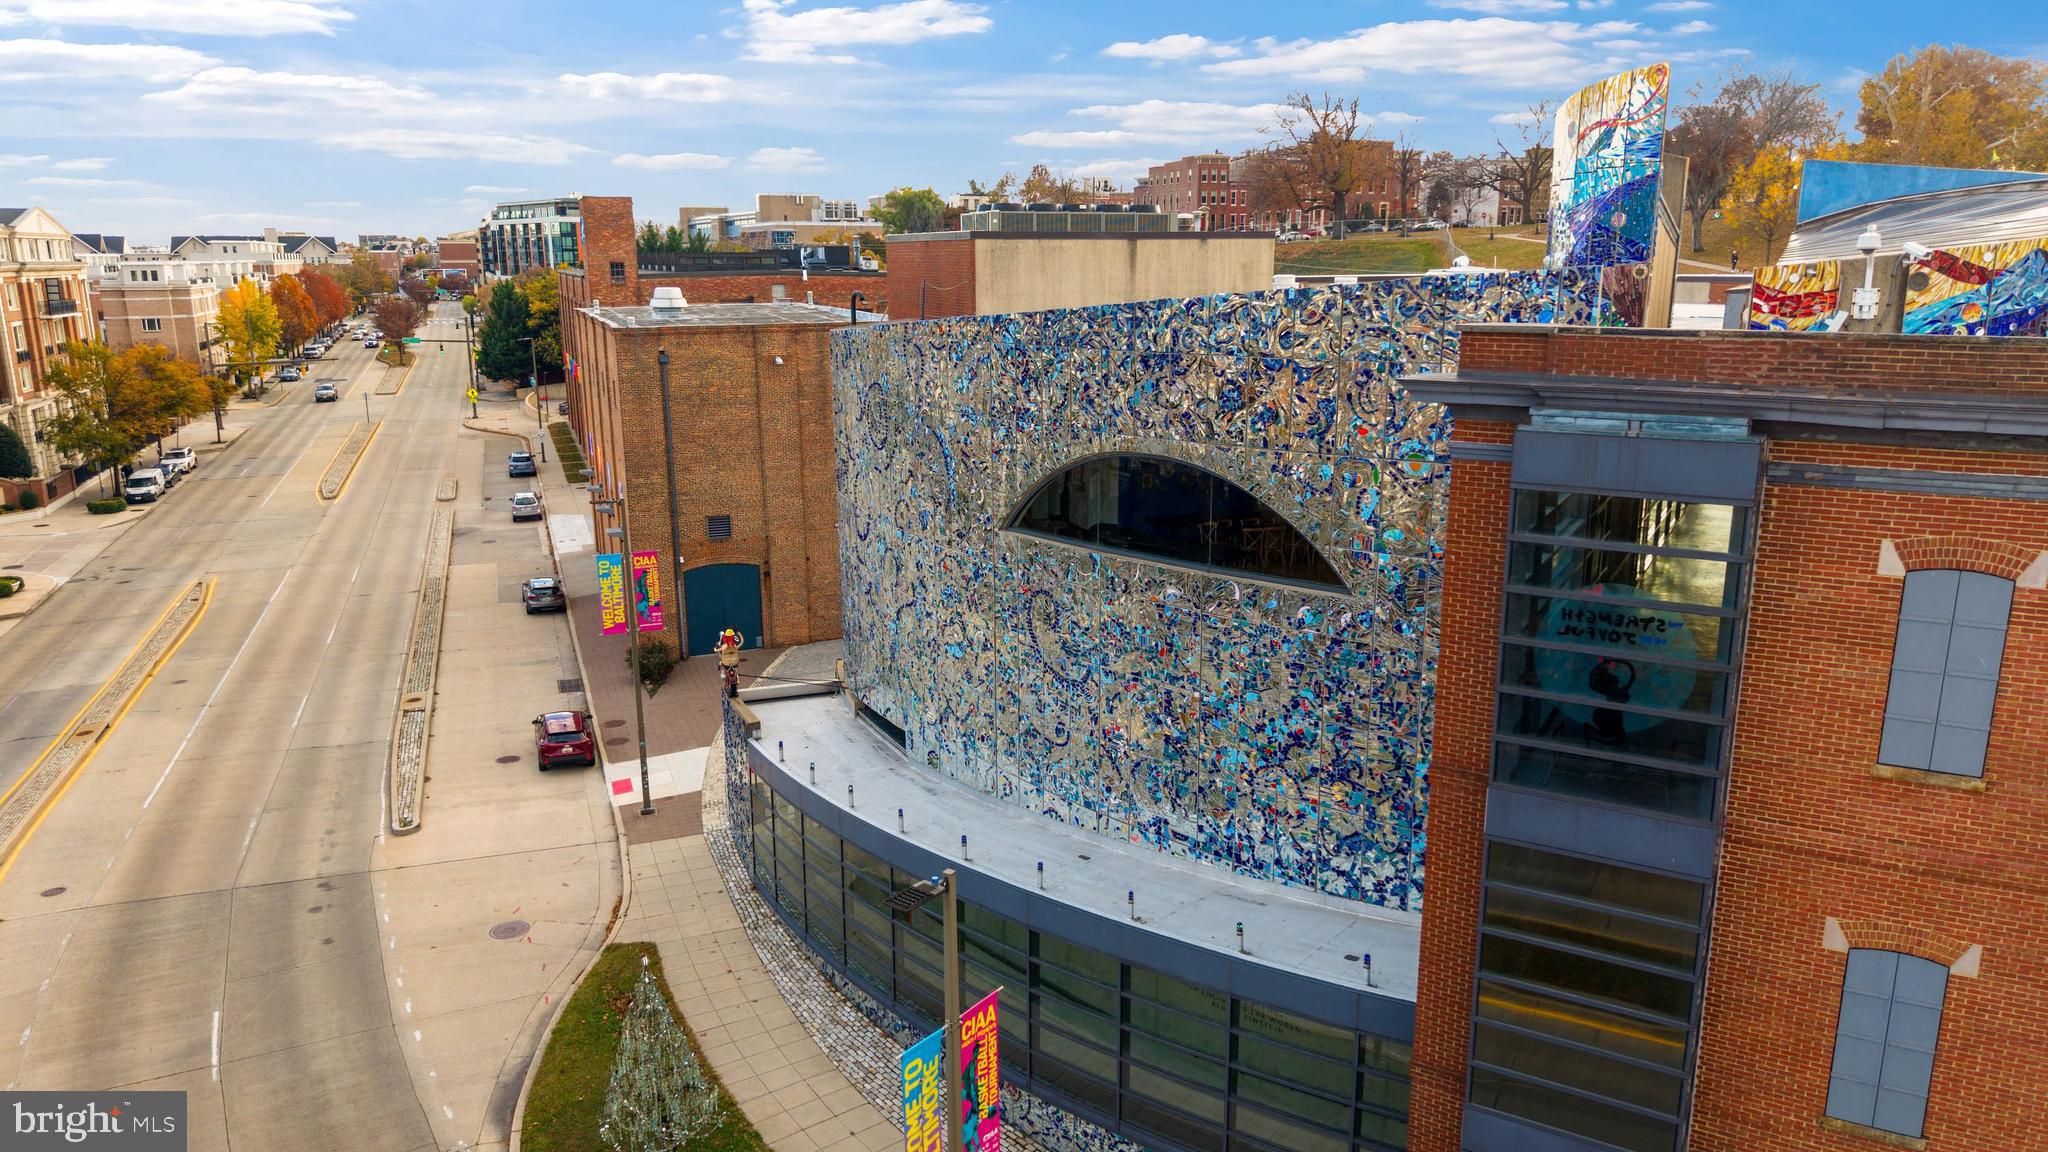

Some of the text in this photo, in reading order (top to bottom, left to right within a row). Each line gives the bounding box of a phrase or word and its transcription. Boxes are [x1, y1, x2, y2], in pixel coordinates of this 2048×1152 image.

[634, 556, 657, 566] CIAA
[598, 560, 615, 629] WELCOME TO
[610, 565, 625, 623] BALTIMORE
[962, 1004, 997, 1041] CIAA
[904, 1058, 923, 1098] TO
[978, 1033, 988, 1119] BASKETBALL
[989, 1030, 998, 1107] TOURNAMENT
